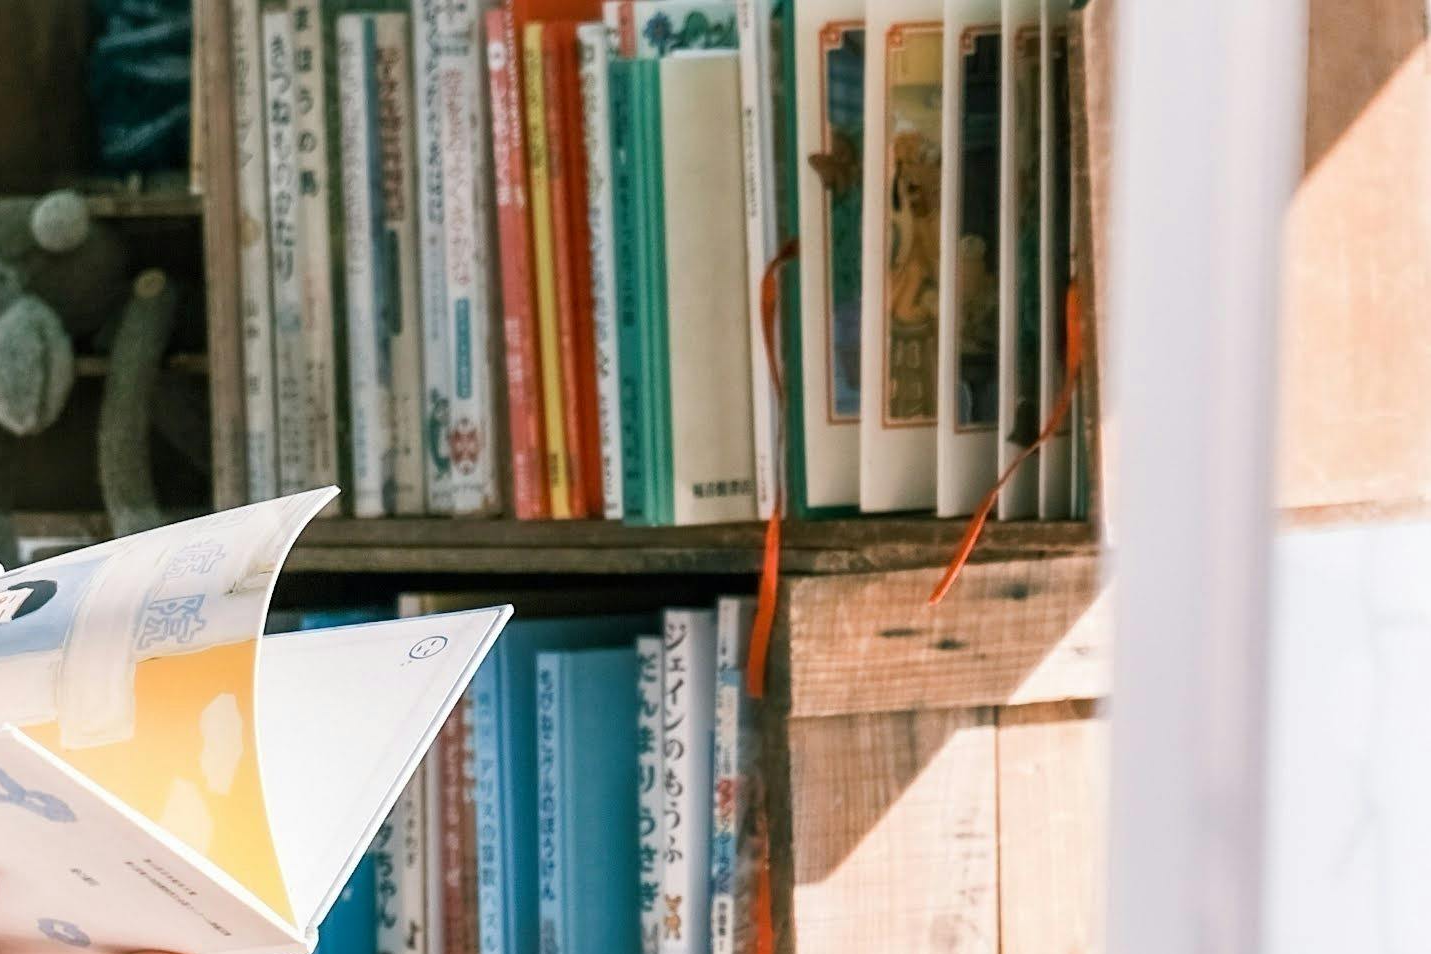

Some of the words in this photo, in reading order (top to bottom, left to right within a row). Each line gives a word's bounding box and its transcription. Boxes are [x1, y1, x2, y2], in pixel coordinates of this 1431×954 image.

[637, 653, 660, 912] だんまりうさぎ
[663, 620, 688, 864] ジェインのもうふ
